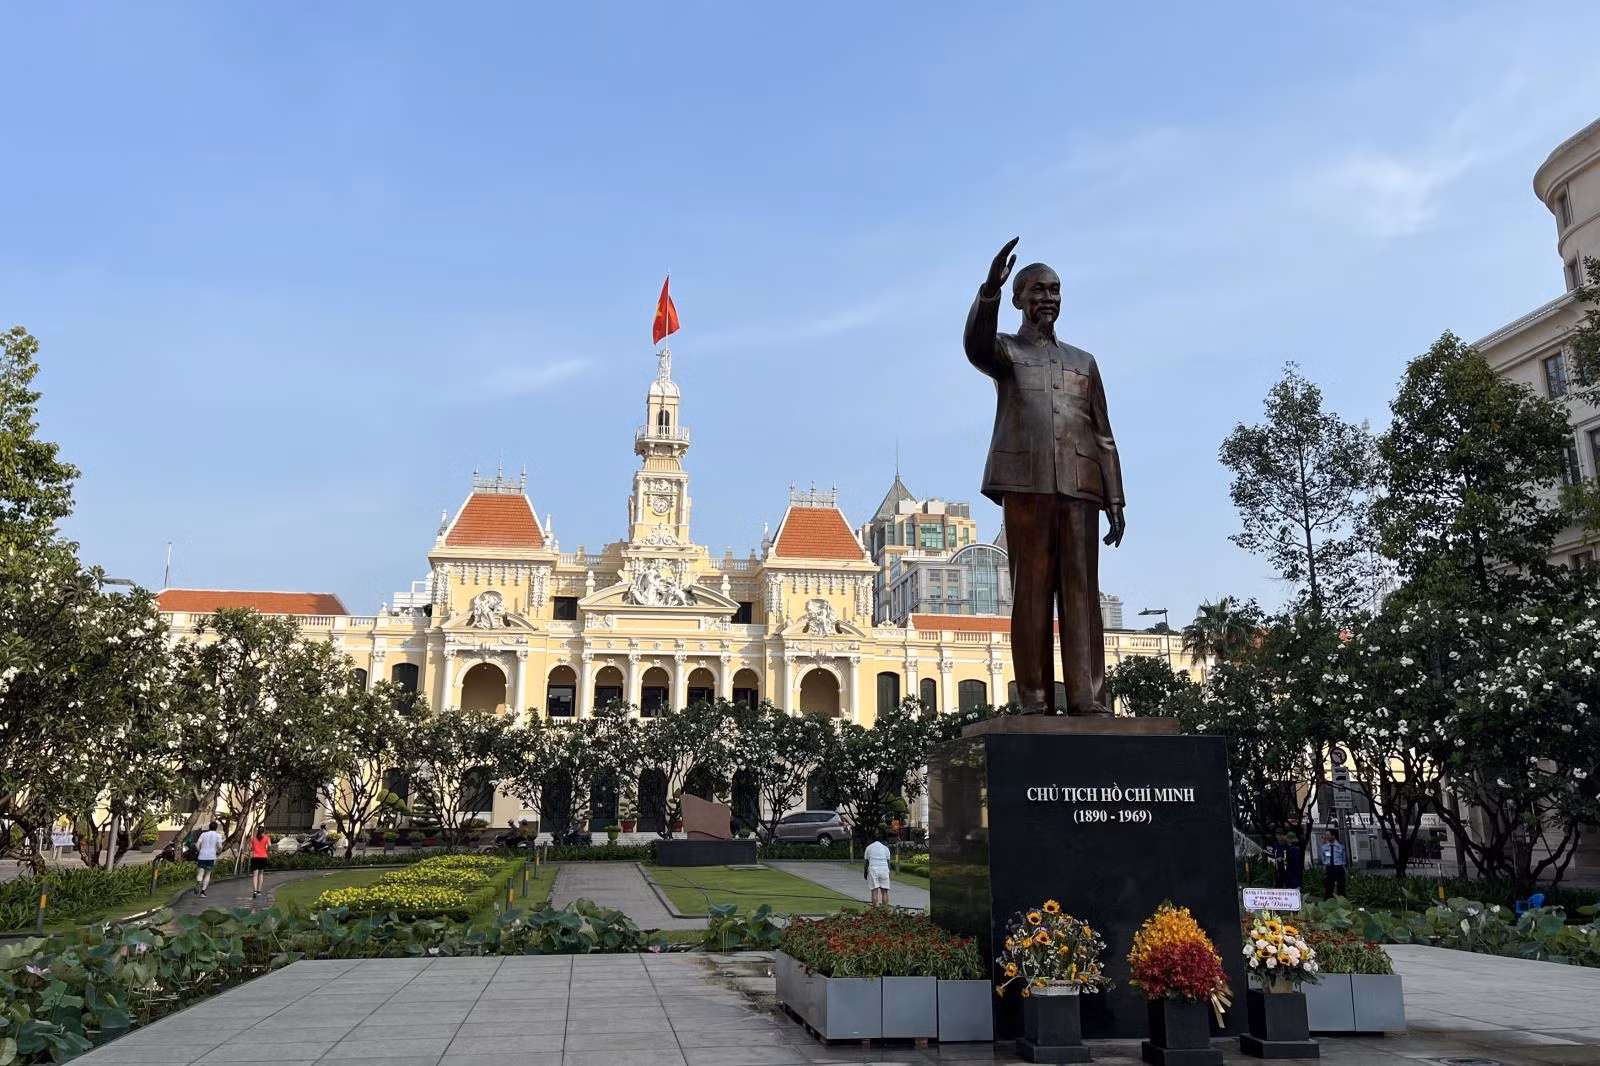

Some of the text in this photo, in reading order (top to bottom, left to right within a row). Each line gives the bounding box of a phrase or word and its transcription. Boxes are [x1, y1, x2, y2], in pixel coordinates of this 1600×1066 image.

[1026, 781, 1195, 804] CHỦ TỊCH HỒ CHÍ MINH
[1073, 809, 1108, 824] (1890
[1118, 809, 1153, 824] 1969)
